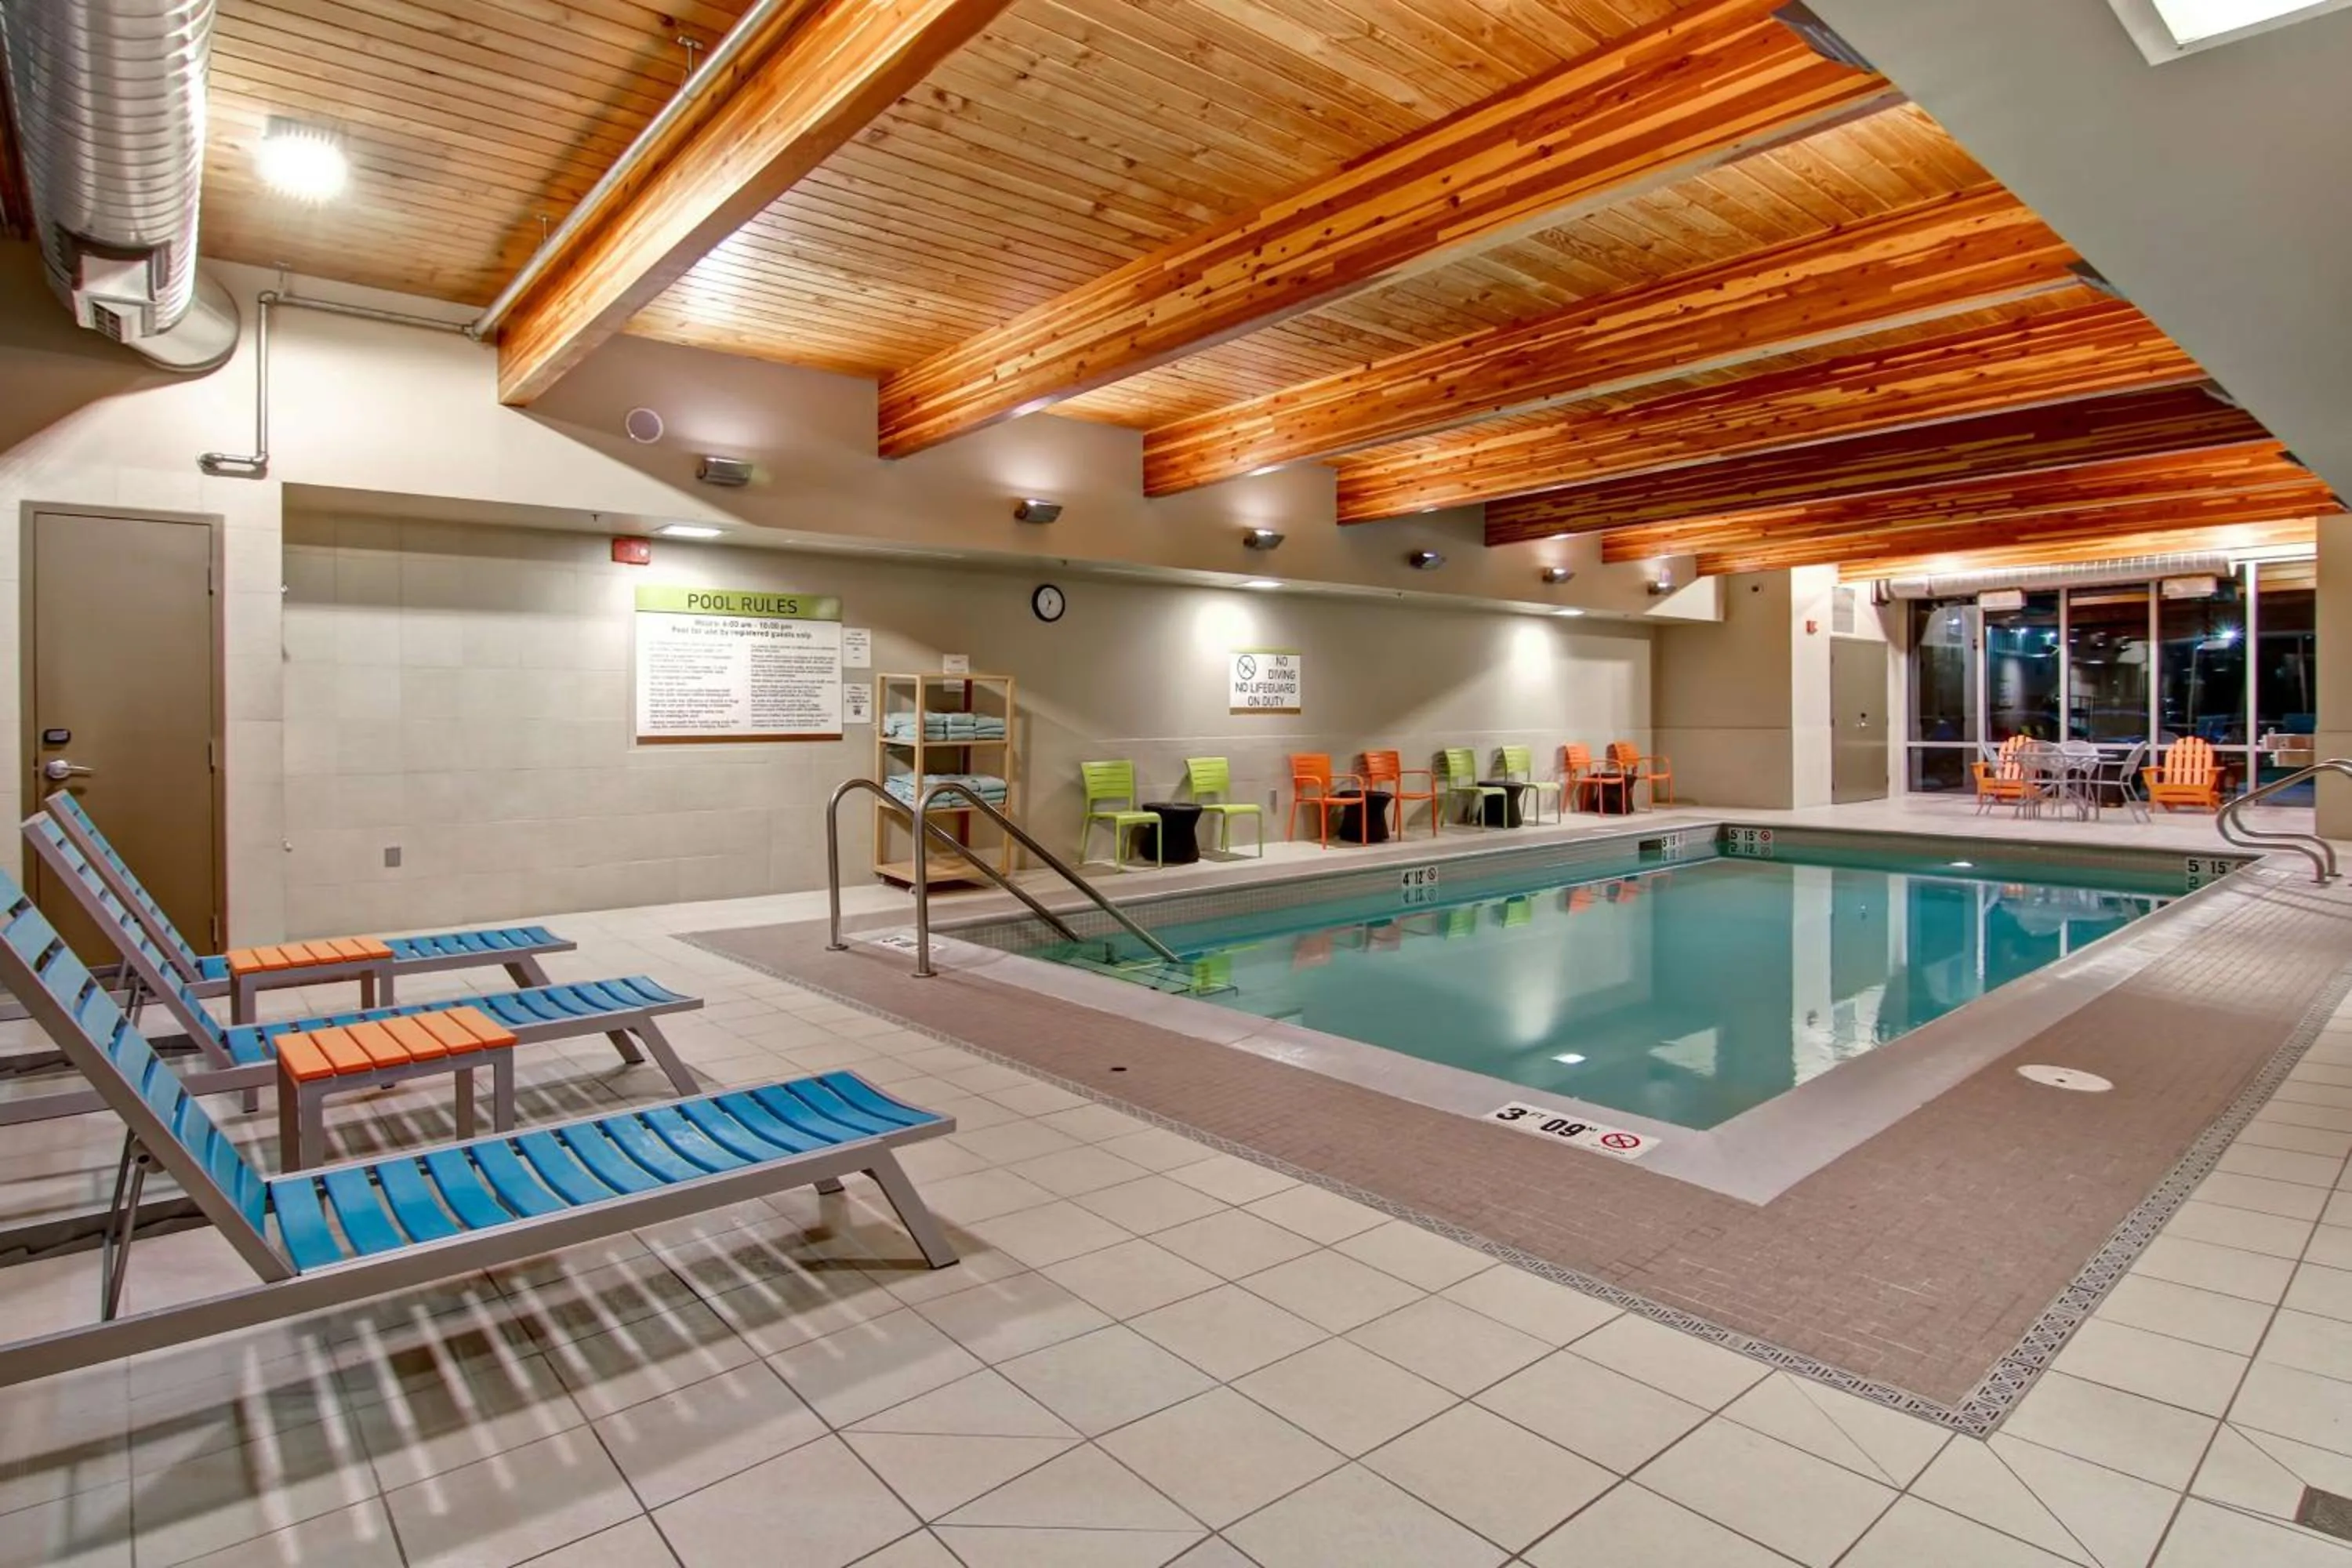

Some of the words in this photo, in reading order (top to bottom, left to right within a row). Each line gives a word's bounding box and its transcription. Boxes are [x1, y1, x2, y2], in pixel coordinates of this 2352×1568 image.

[688, 593, 735, 611] POOL
[742, 597, 797, 614] RULES
[731, 629, 768, 637] registered
[771, 630, 794, 639] guests
[1276, 655, 1288, 666] NO
[1268, 669, 1296, 680] DIVING
[1235, 682, 1248, 693] NO
[1250, 682, 1296, 694] LIFEGUARD
[1247, 695, 1260, 706] ON
[1261, 695, 1285, 706] DUTY
[1730, 829, 1738, 840] 5
[2187, 859, 2200, 873] 5
[1403, 872, 1410, 886] 4
[1496, 1108, 1528, 1120] 3
